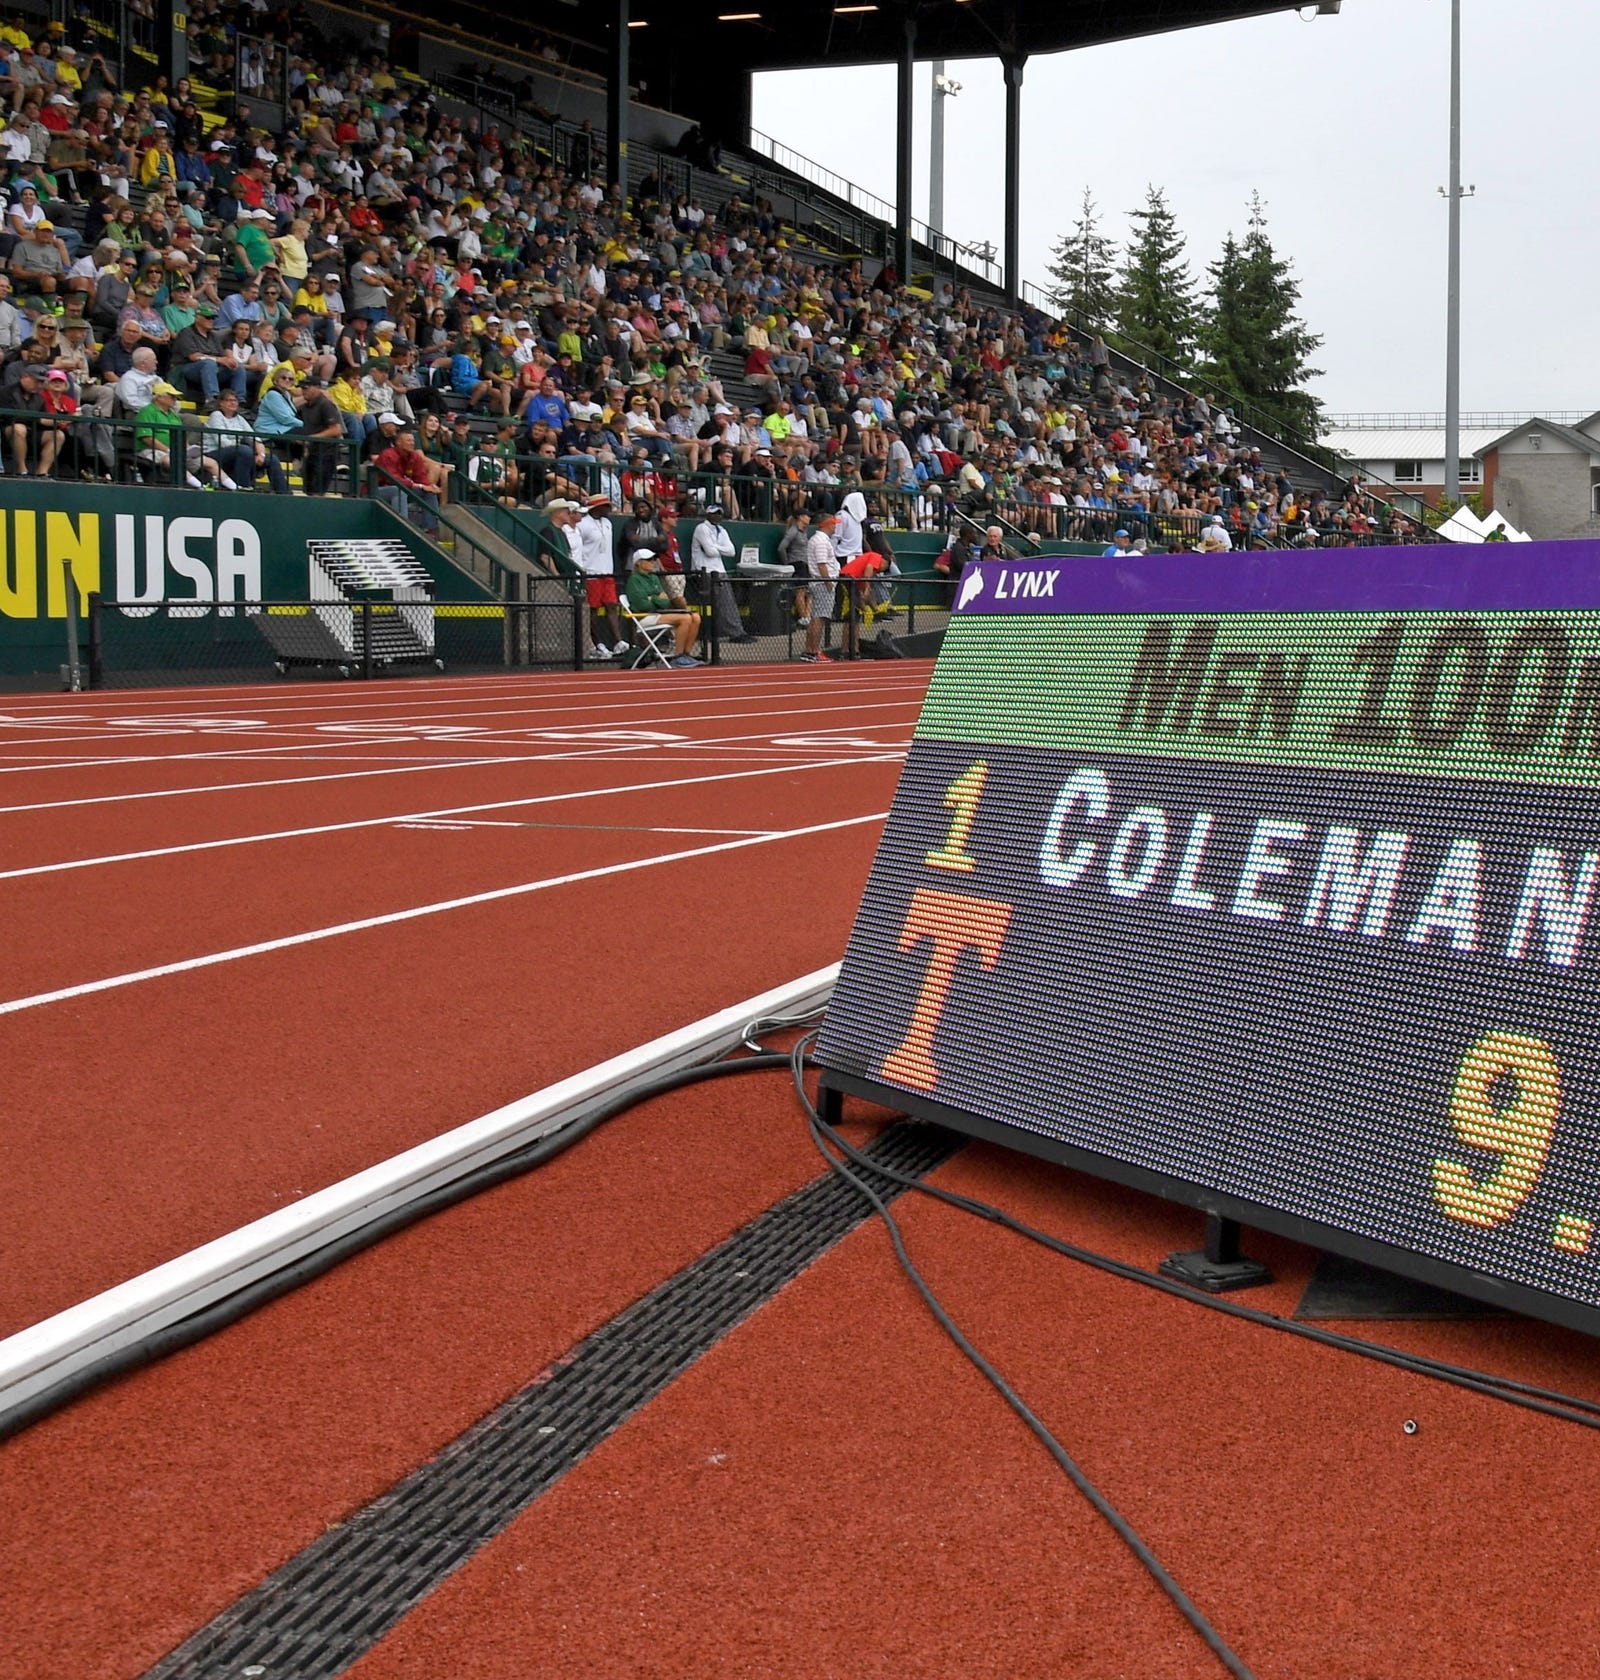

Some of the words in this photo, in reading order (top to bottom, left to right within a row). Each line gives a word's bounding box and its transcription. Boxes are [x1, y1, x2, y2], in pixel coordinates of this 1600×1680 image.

[115, 513, 262, 618] USA
[994, 569, 1060, 598] LYNX
[1118, 618, 1309, 738] MEN
[924, 758, 989, 872] 1
[879, 886, 1014, 1092] T
